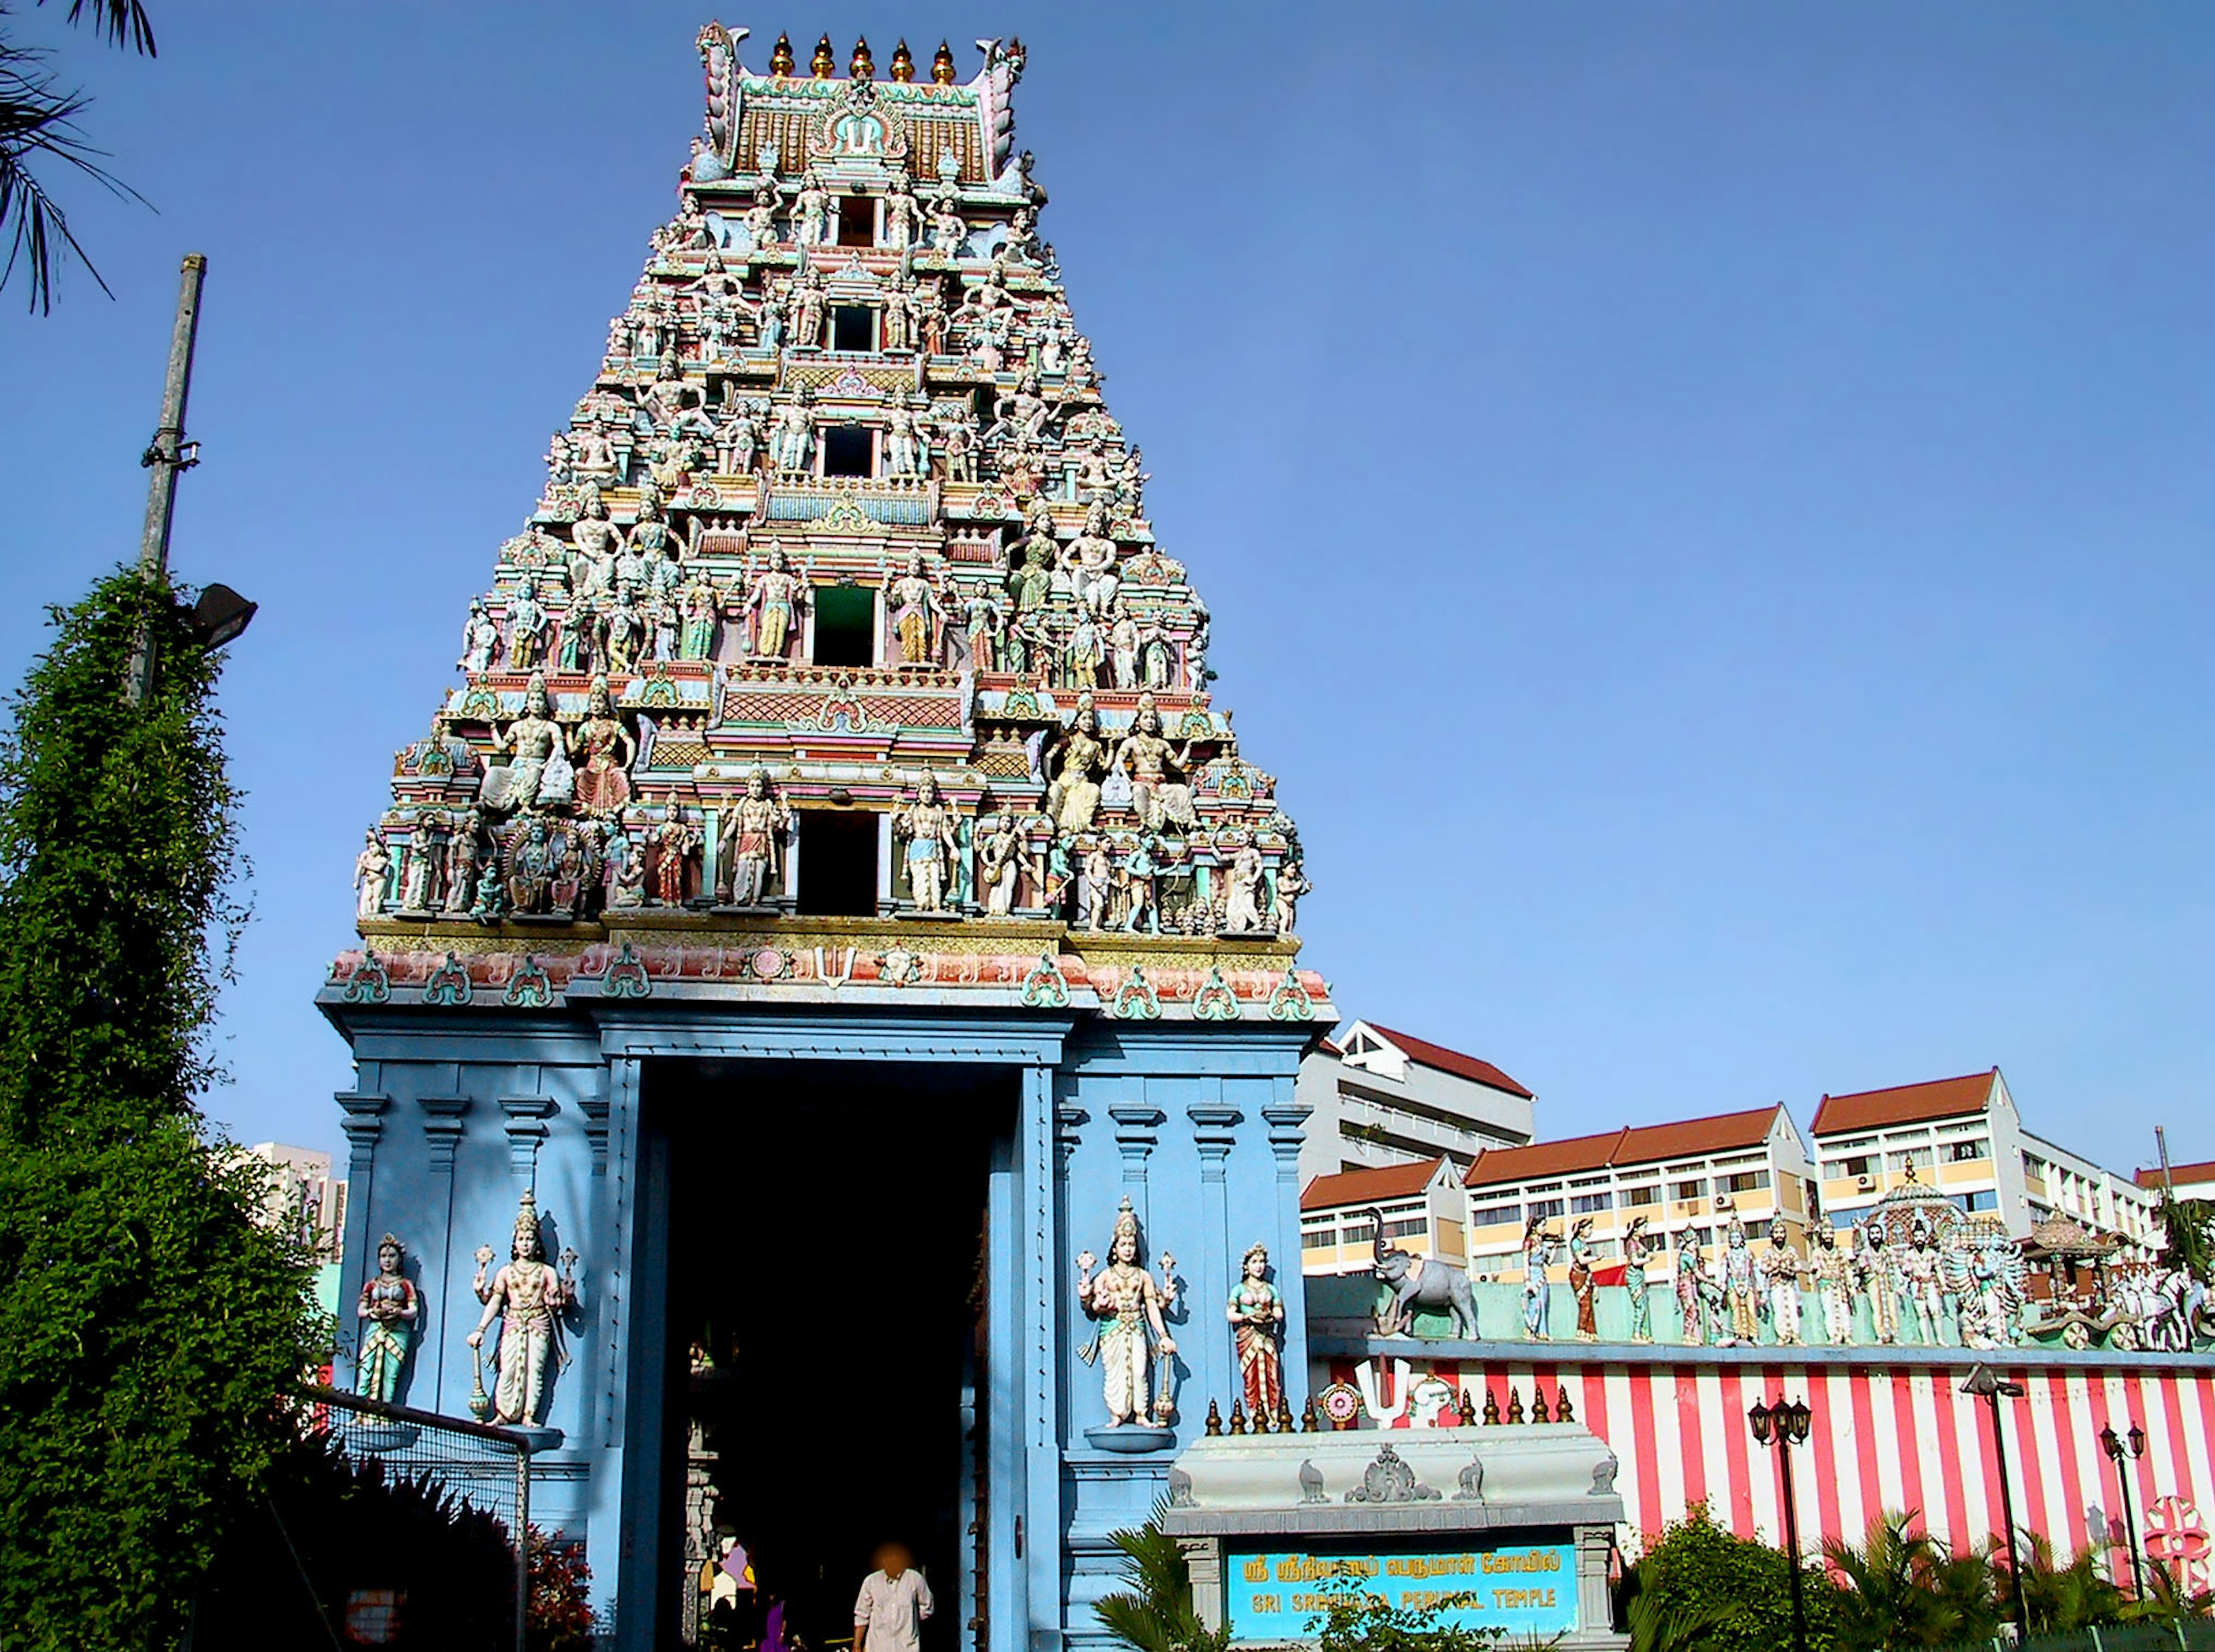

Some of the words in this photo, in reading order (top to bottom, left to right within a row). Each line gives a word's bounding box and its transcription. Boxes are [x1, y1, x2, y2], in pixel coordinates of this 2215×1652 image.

[1481, 1549, 1560, 1574] கோயில்
[1252, 1593, 1281, 1613] SRI
[1492, 1588, 1556, 1608] TEMPLE
